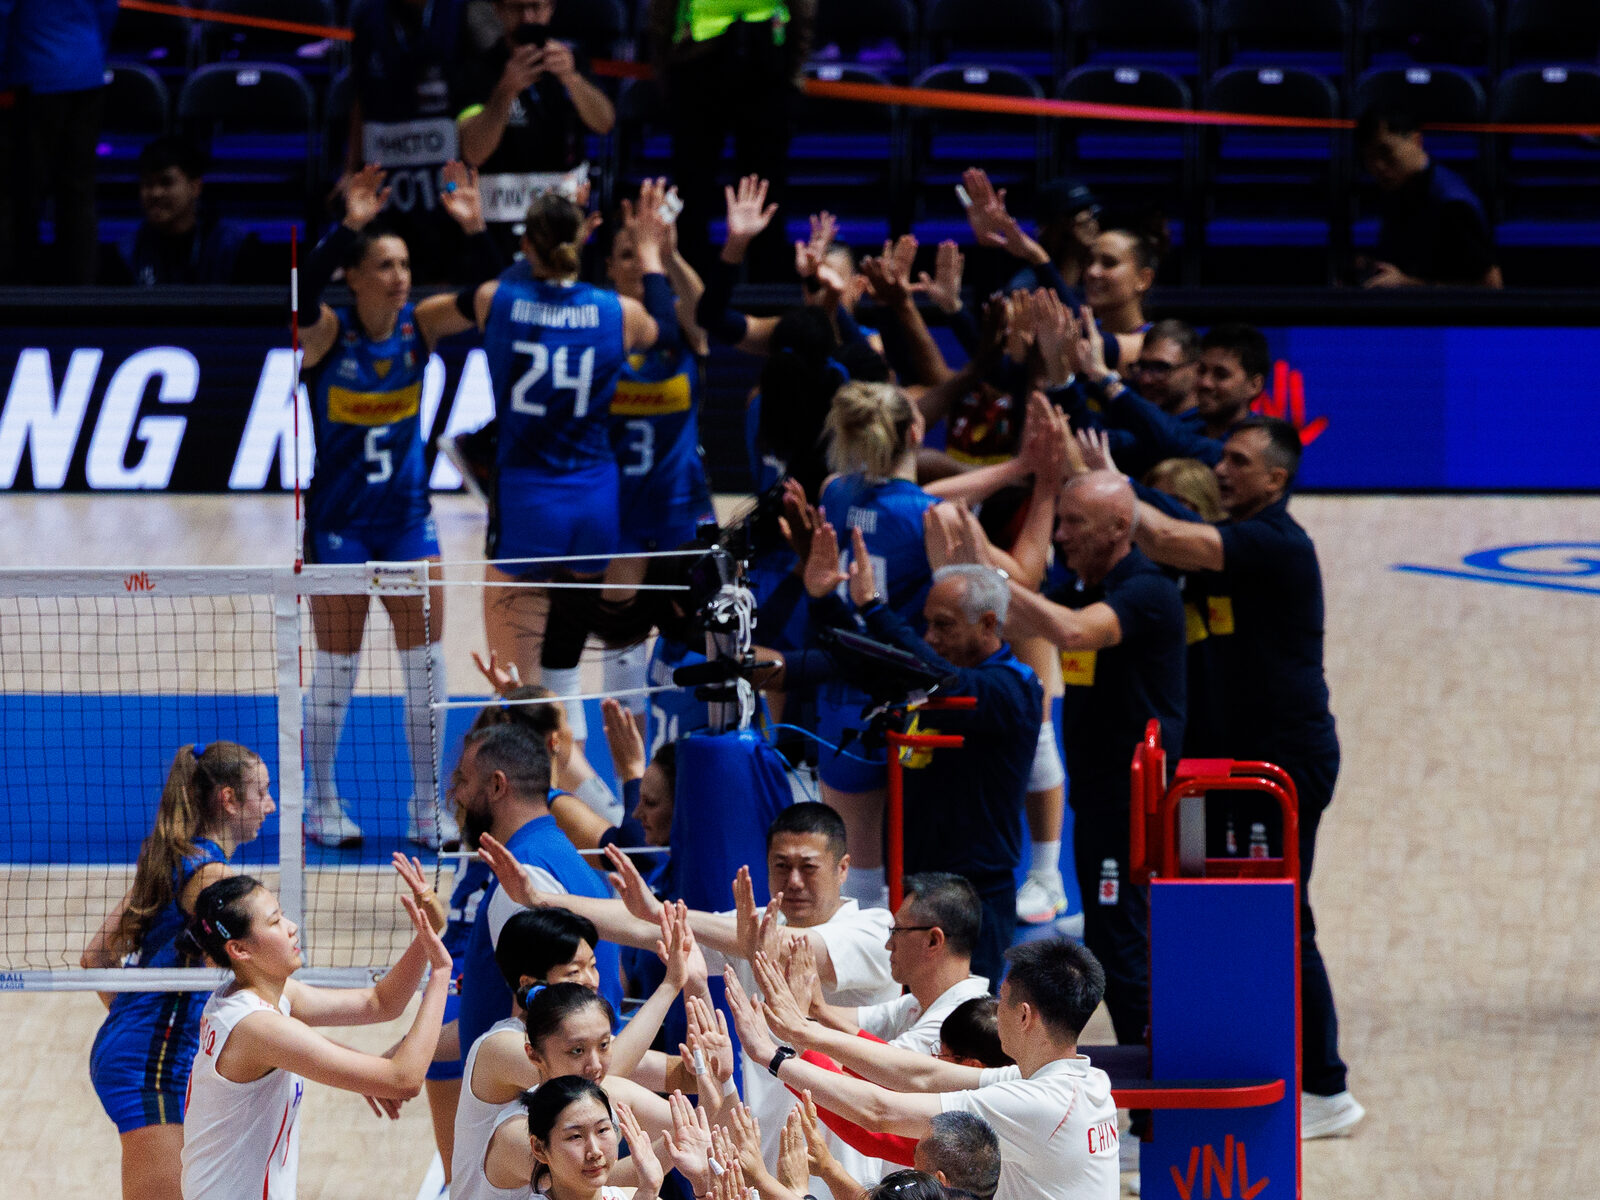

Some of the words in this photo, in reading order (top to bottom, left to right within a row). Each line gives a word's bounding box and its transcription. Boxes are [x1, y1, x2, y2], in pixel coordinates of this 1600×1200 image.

[511, 341, 595, 417] 24
[364, 426, 393, 484] 5
[624, 420, 655, 475] 3
[124, 571, 155, 592] VNL
[1088, 1122, 1118, 1154] CHIN
